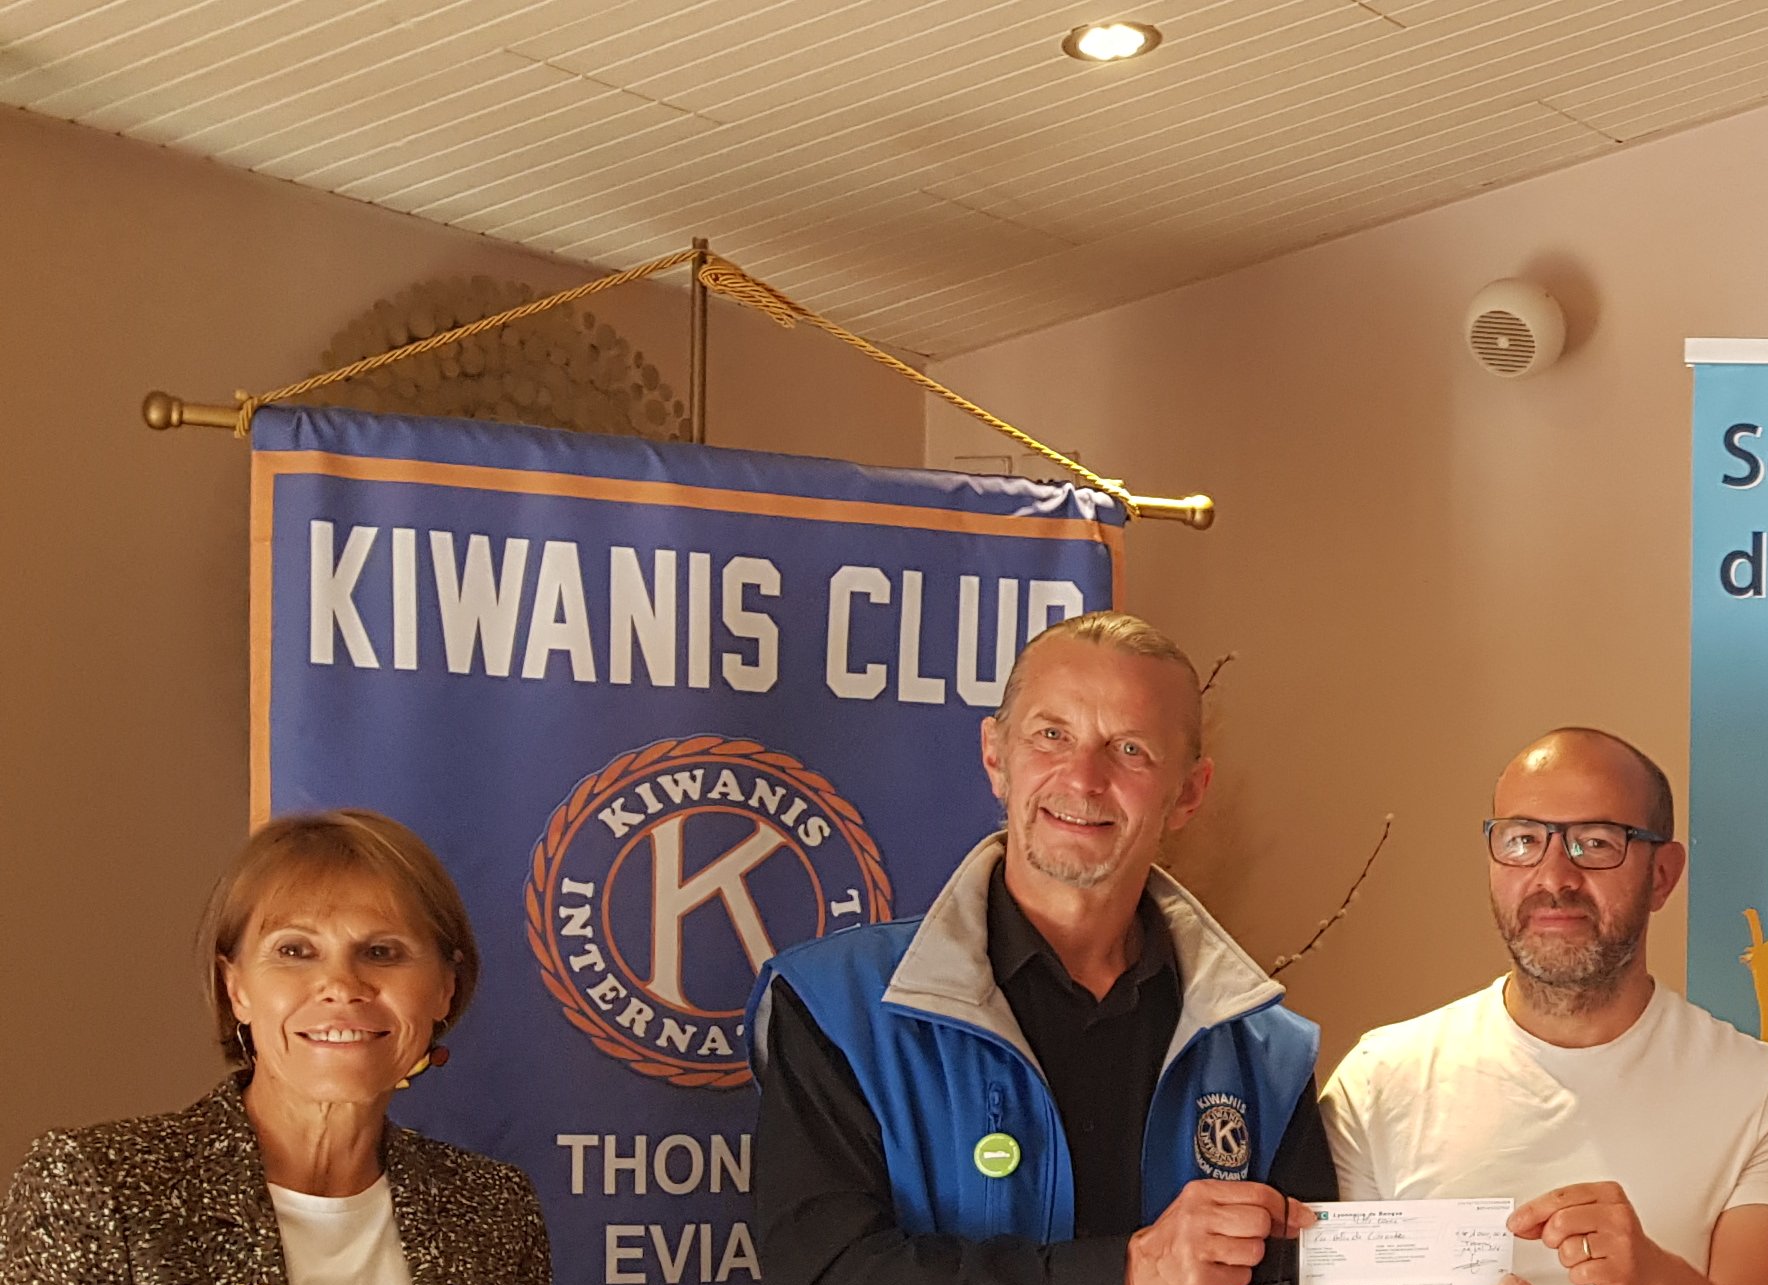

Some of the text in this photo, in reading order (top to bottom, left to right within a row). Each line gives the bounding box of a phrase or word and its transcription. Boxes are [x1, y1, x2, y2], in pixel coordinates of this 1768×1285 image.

[308, 518, 782, 694] KIWANIS
[598, 768, 831, 854] KIWANIS
[644, 813, 788, 1011] K
[1196, 1093, 1247, 1114] KIWANIS
[556, 1134, 752, 1195] THON
[1215, 1119, 1240, 1154] K
[605, 1223, 760, 1285] EVIA
